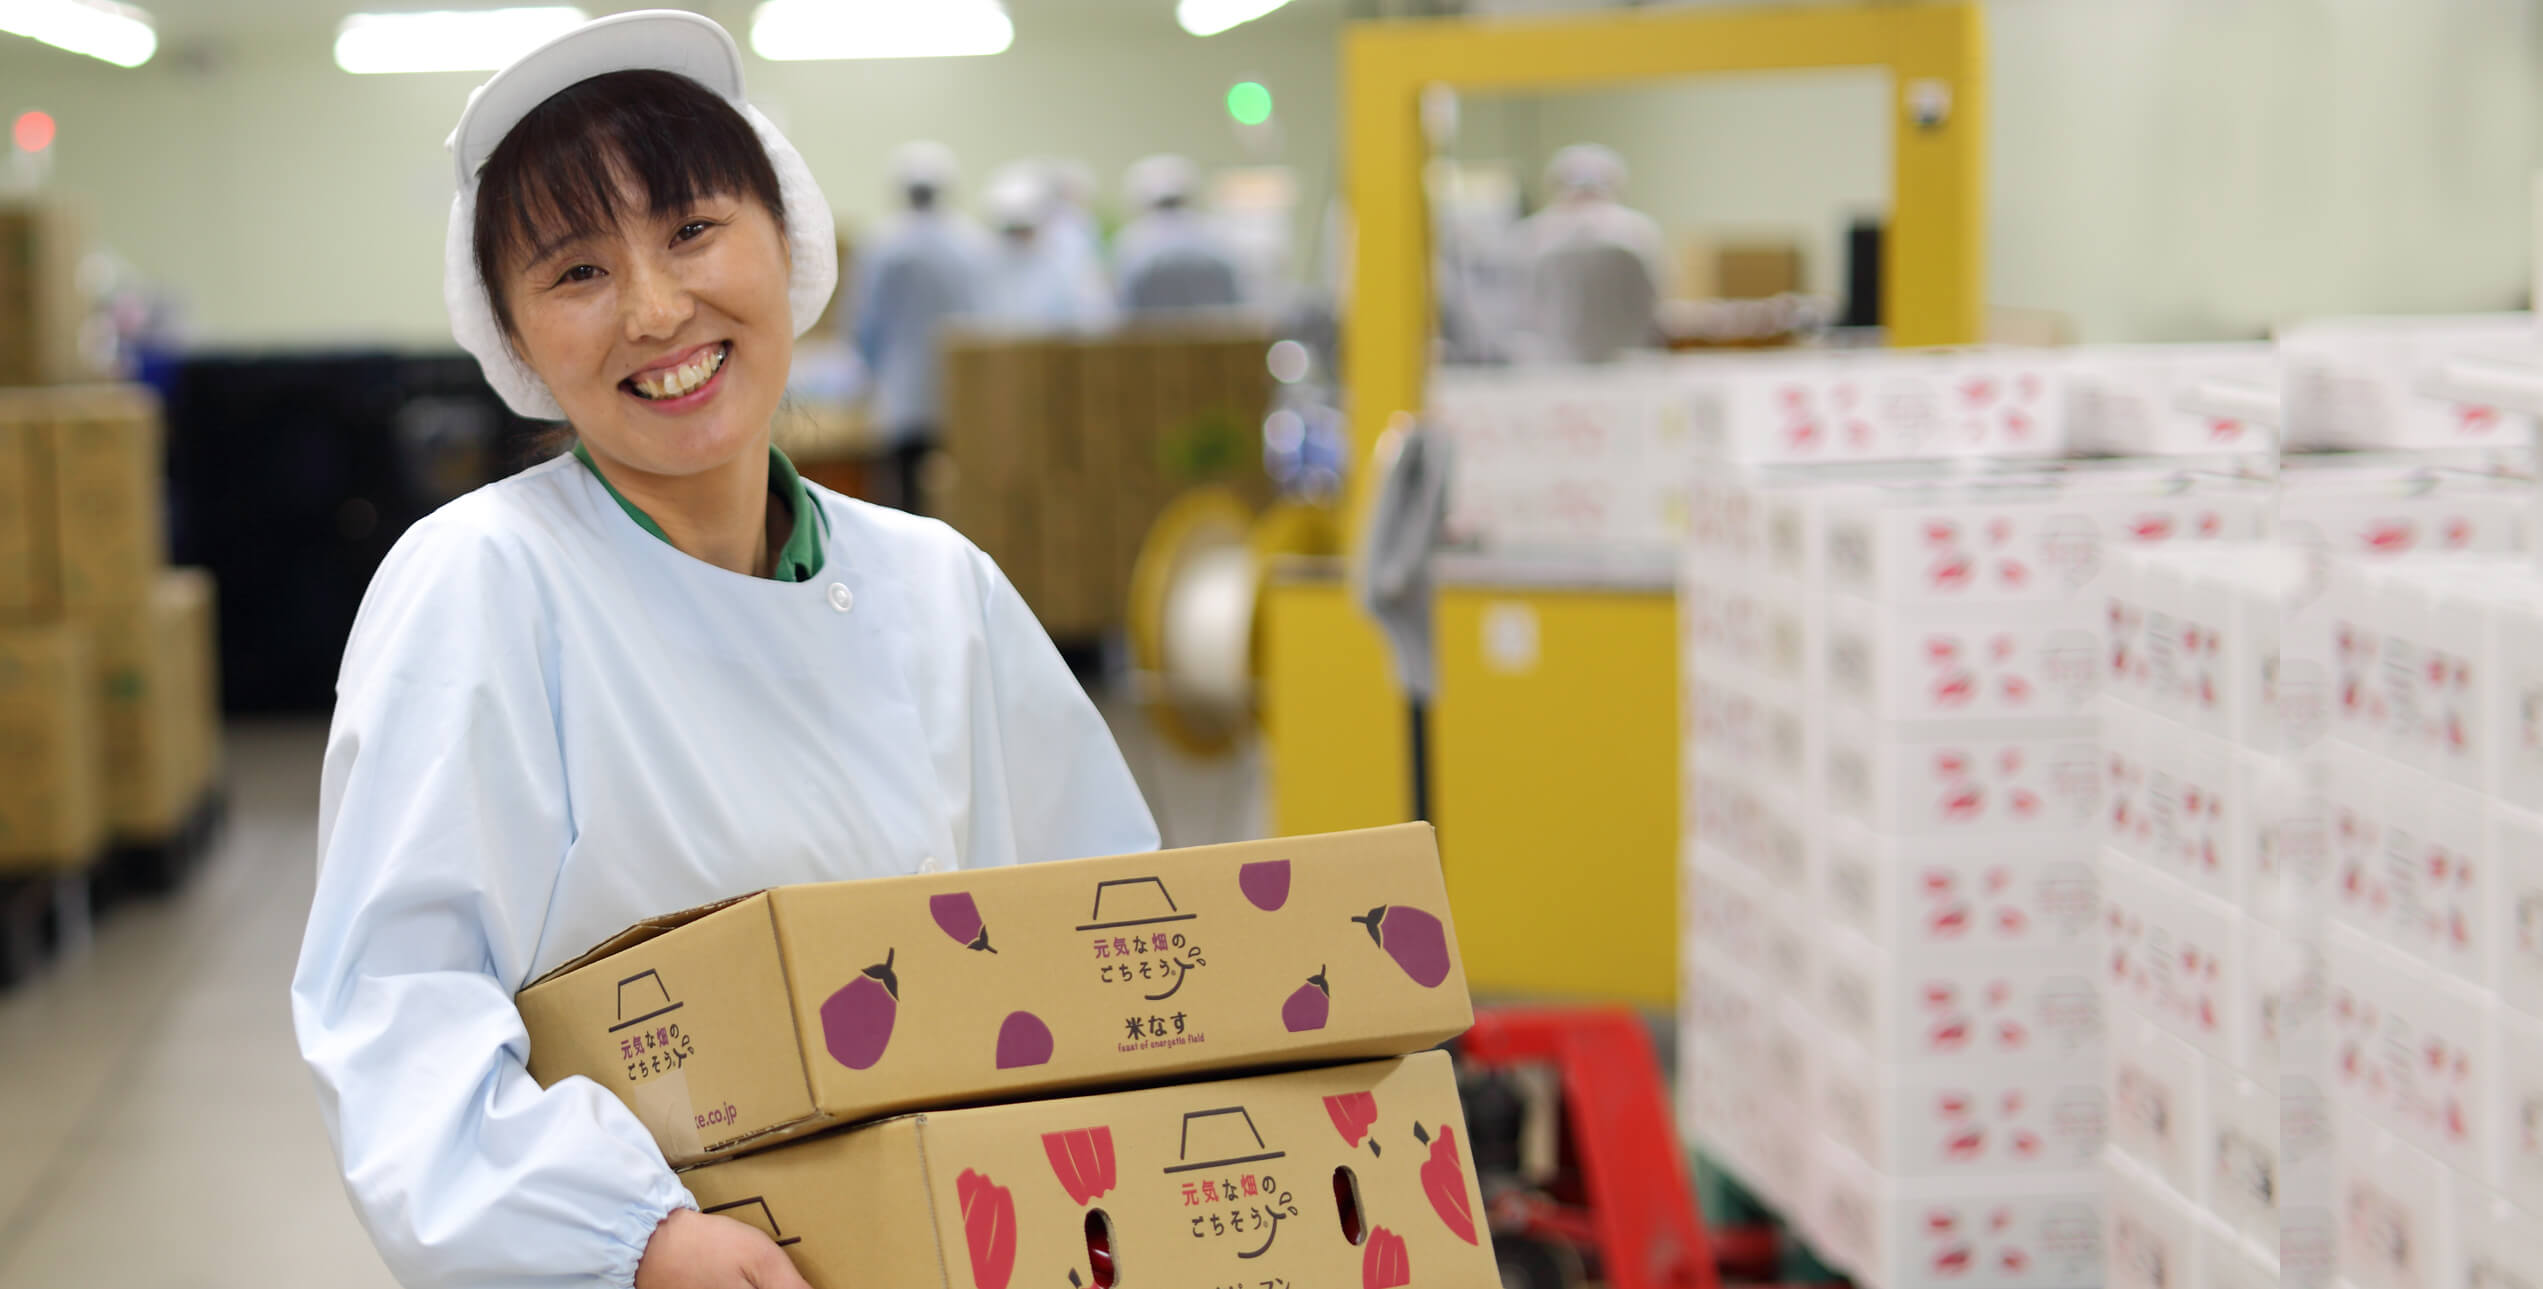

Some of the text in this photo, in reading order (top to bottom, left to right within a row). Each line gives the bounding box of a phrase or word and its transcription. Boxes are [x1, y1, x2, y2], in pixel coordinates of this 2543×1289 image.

[1093, 933, 1186, 959] 元気な畑の
[1125, 1011, 1188, 1040] 米なす
[621, 1024, 679, 1060] 元気な畑の
[1181, 1174, 1276, 1207] 元気な畑の
